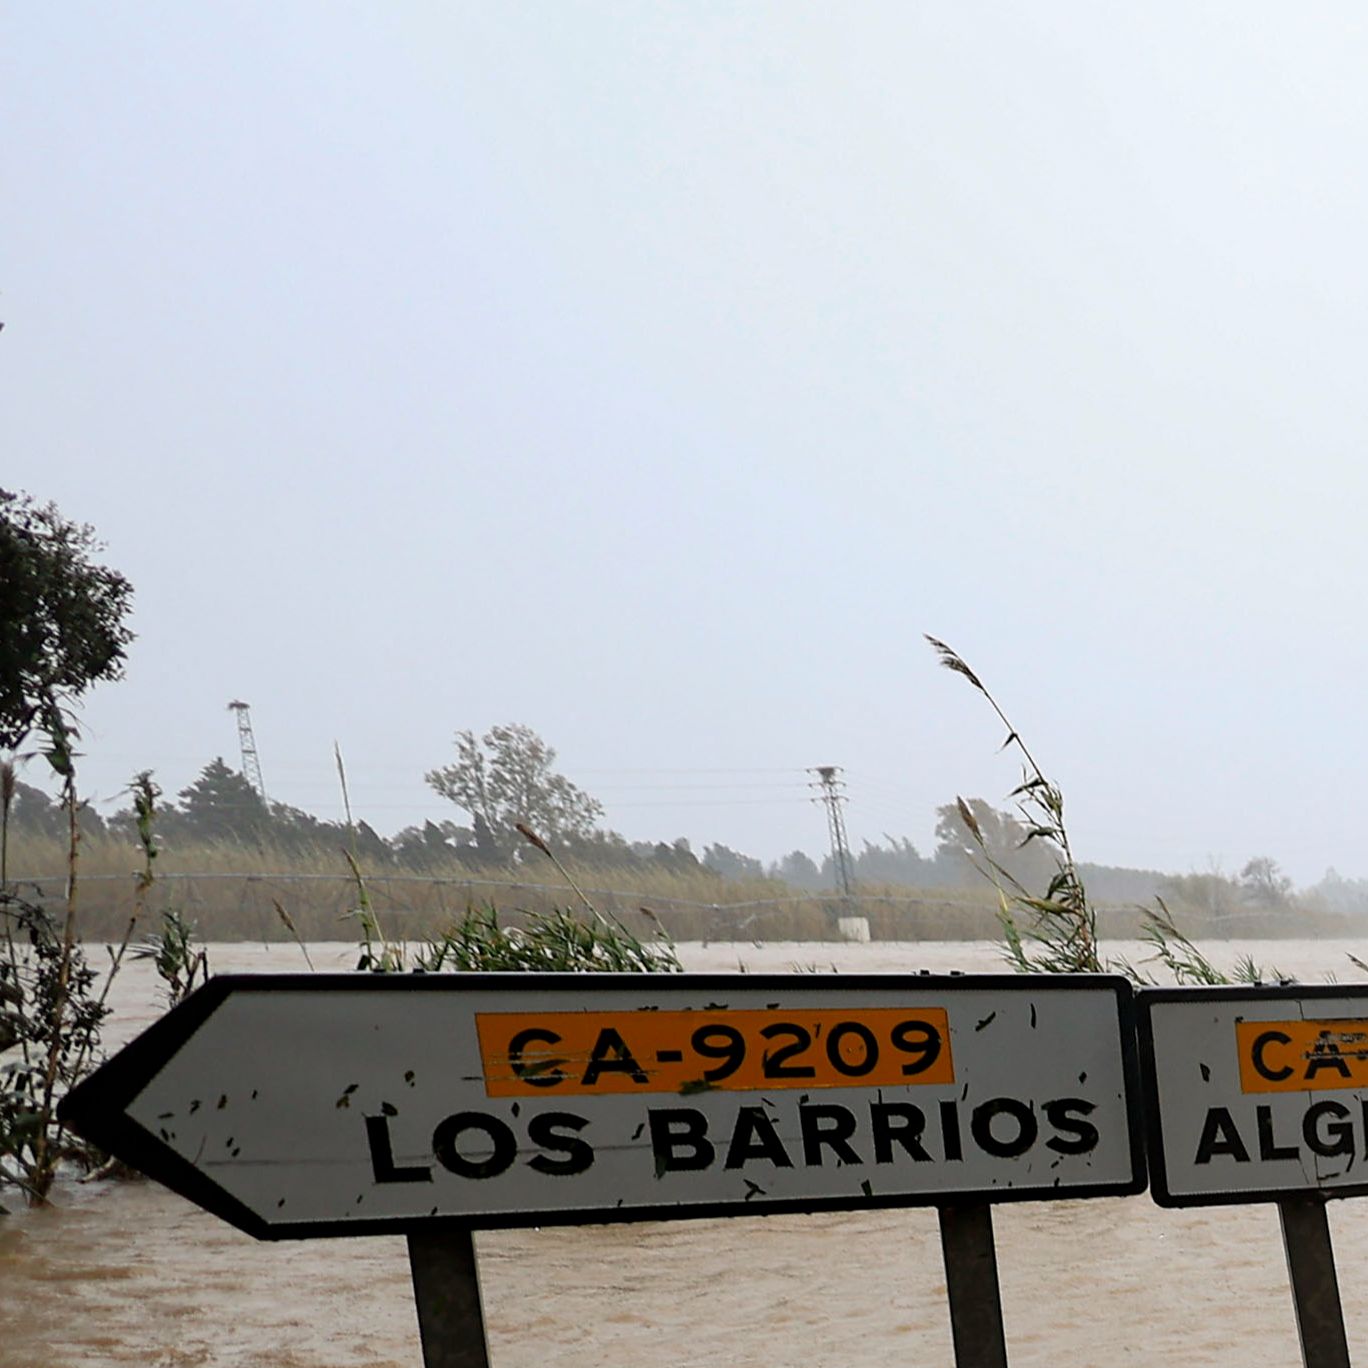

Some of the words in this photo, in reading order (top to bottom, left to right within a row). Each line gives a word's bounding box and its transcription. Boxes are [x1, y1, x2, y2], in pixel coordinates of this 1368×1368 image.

[507, 1020, 943, 1086] CA-9209
[364, 1109, 597, 1184] LOS
[646, 1097, 1100, 1173] BARRIOS
